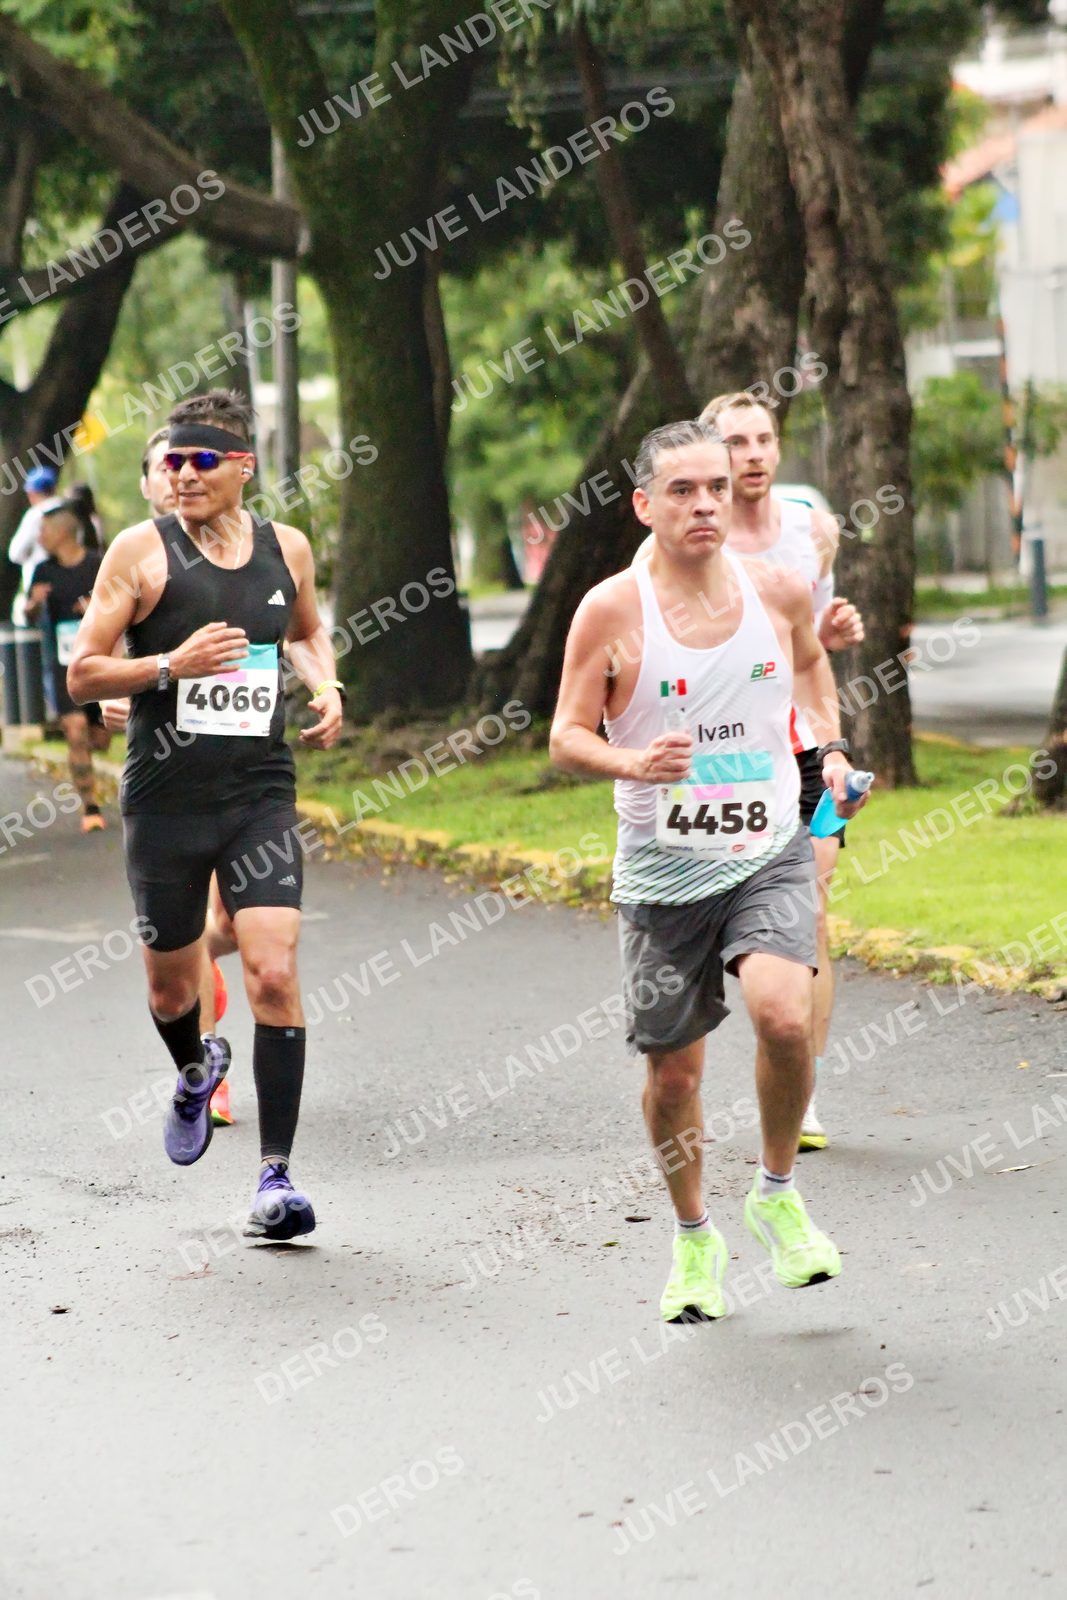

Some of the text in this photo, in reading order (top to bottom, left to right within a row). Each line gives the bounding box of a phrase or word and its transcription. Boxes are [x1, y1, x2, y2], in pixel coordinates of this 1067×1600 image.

[186, 683, 271, 713] 4066
[698, 720, 745, 743] Ivan
[666, 800, 768, 836] 4458
